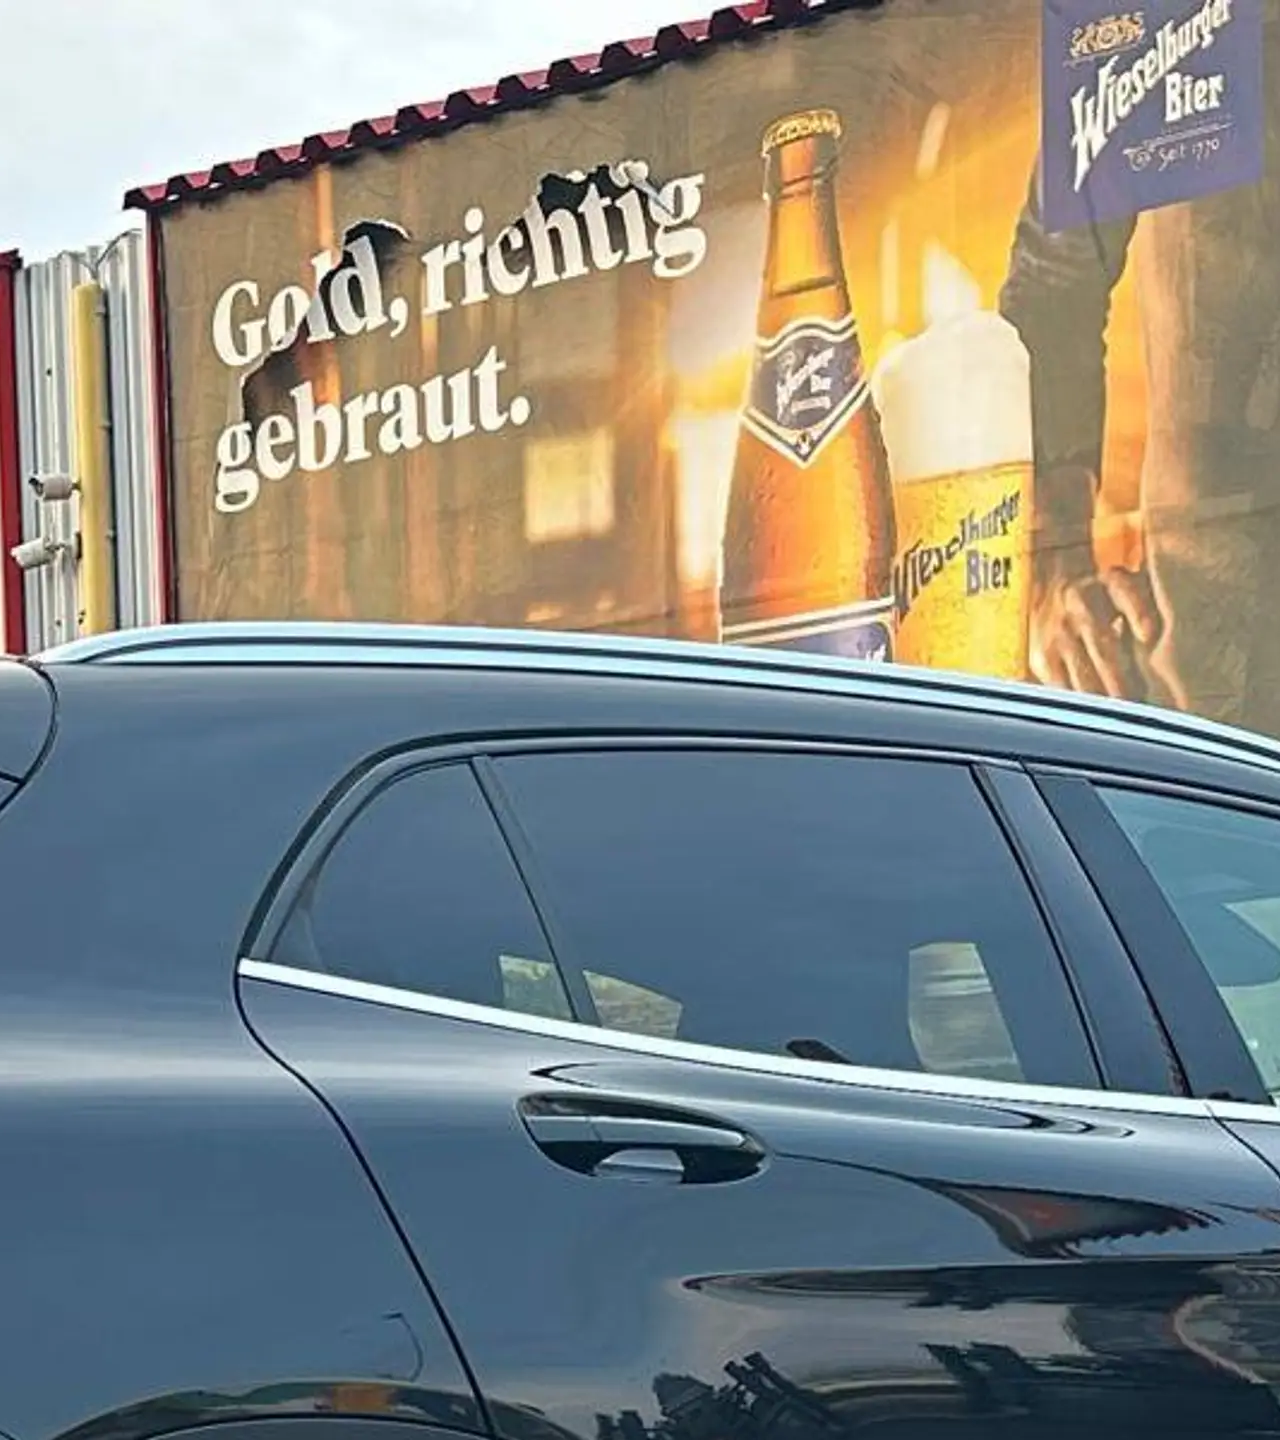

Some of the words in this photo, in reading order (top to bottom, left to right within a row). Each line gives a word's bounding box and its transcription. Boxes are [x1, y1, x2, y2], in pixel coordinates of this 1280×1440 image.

[1070, 0, 1232, 193] Wieselburger
[1165, 72, 1224, 122] Bier
[213, 235, 408, 368] Gold,
[422, 162, 706, 279] richtig
[215, 345, 531, 513] gebraut.
[966, 550, 1012, 597] Bier
